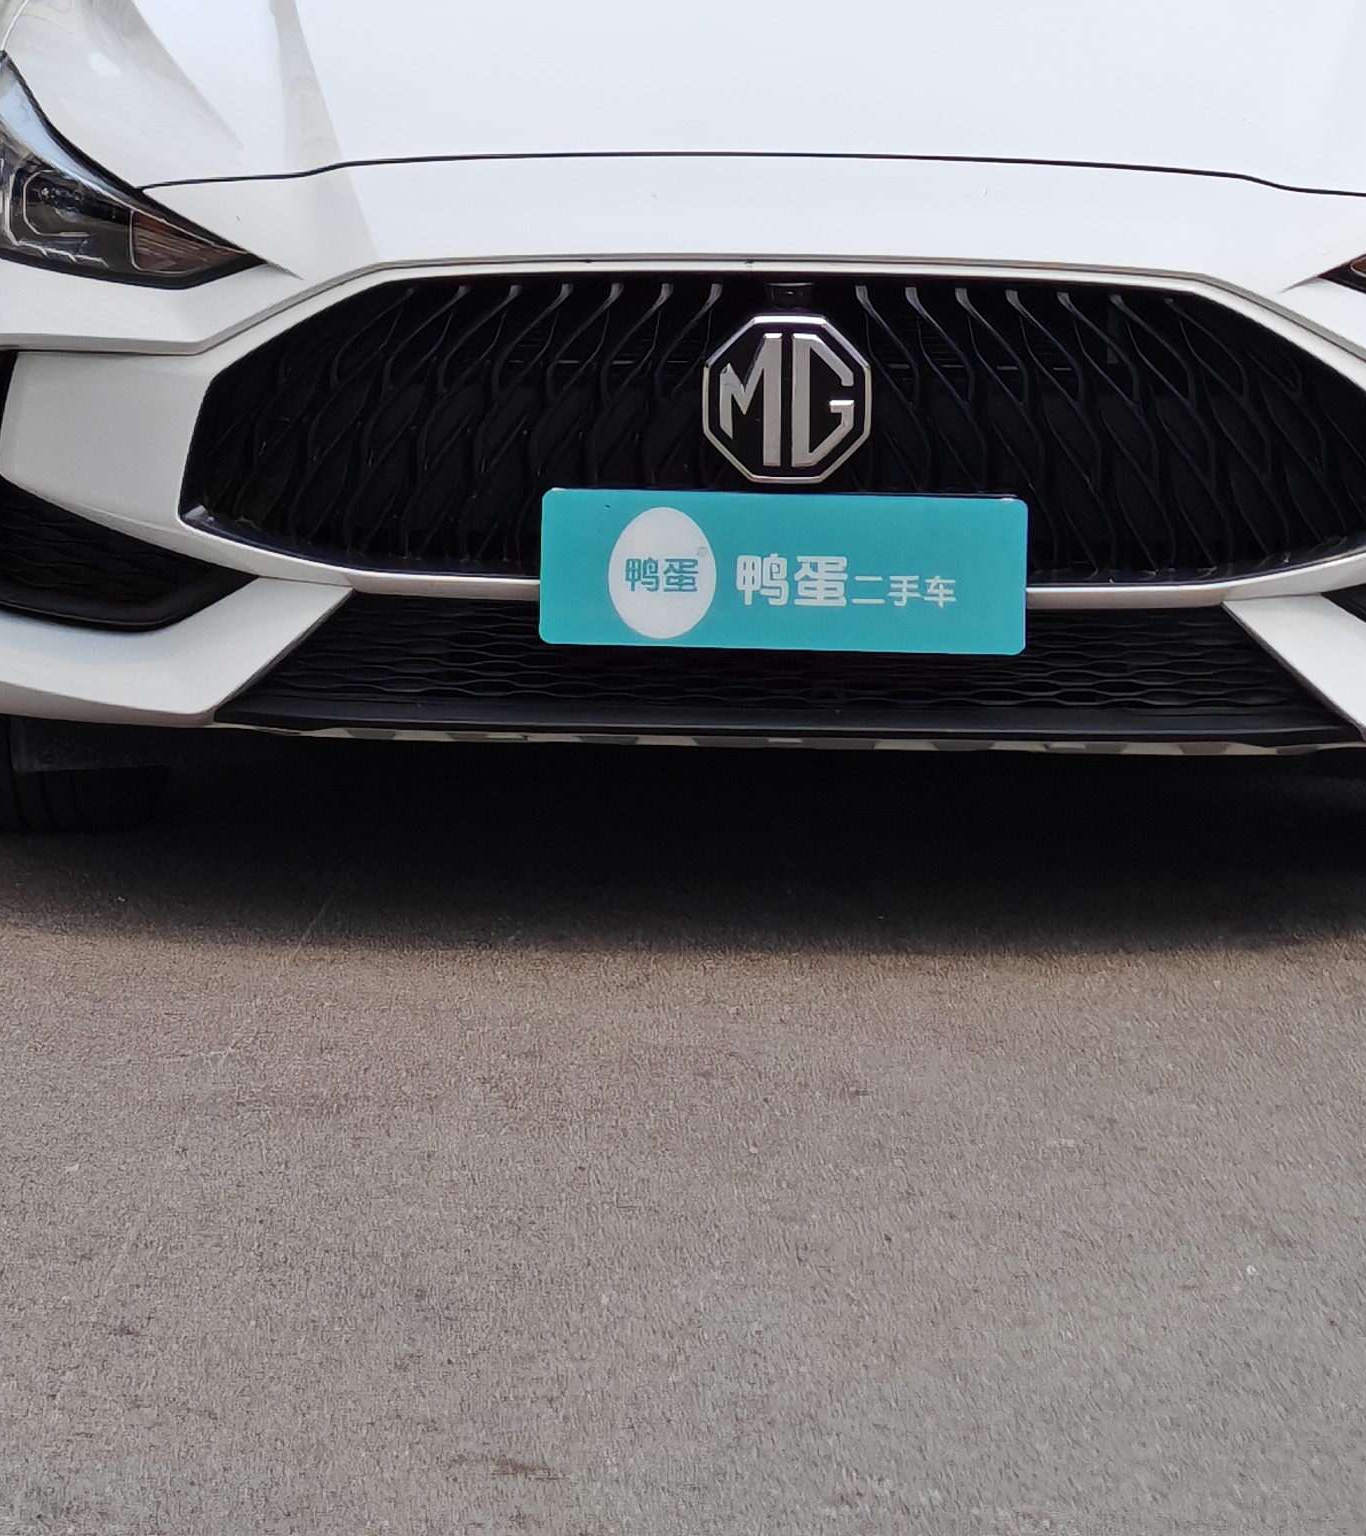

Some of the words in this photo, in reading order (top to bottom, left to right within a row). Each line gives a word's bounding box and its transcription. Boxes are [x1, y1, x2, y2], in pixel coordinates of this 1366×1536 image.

[719, 332, 855, 468] MG
[624, 557, 699, 593] 鸭蛋
[736, 552, 957, 608] 鸭蛋二手车
